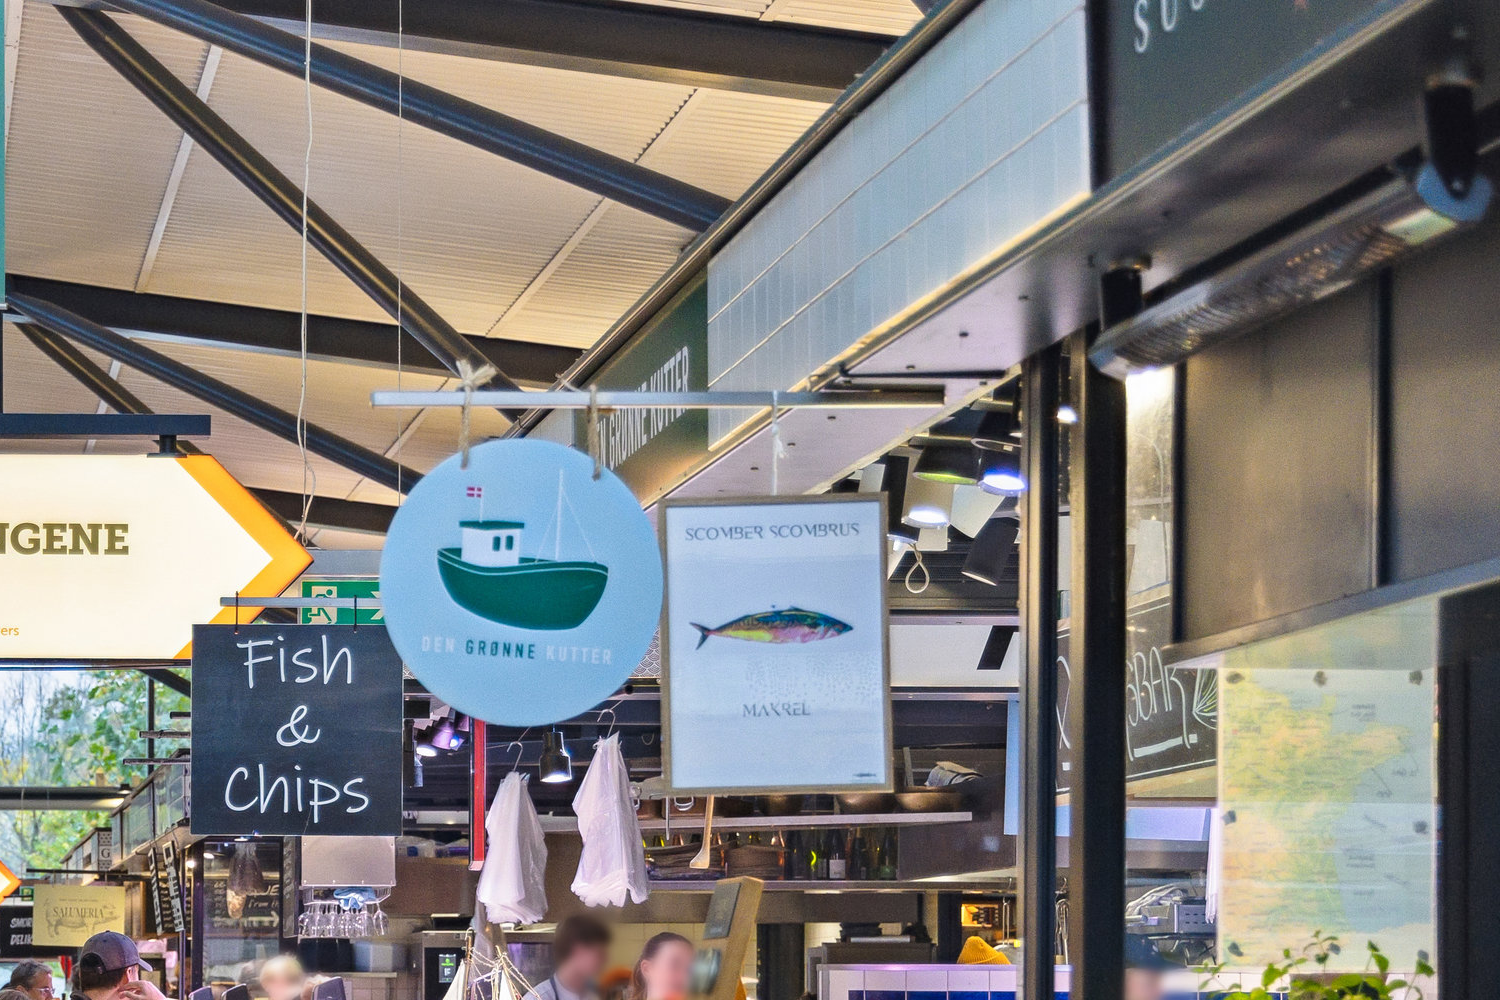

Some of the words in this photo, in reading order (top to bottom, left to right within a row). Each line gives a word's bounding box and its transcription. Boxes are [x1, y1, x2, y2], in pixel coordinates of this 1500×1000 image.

[237, 634, 353, 689] Fish
[422, 635, 455, 653] DEN
[465, 639, 536, 660] GRØNNE
[546, 645, 612, 665] KUTTER
[276, 704, 321, 748] &
[224, 764, 370, 825] Chips
[101, 847, 111, 859] G
[53, 906, 104, 919] SALUMERIA
